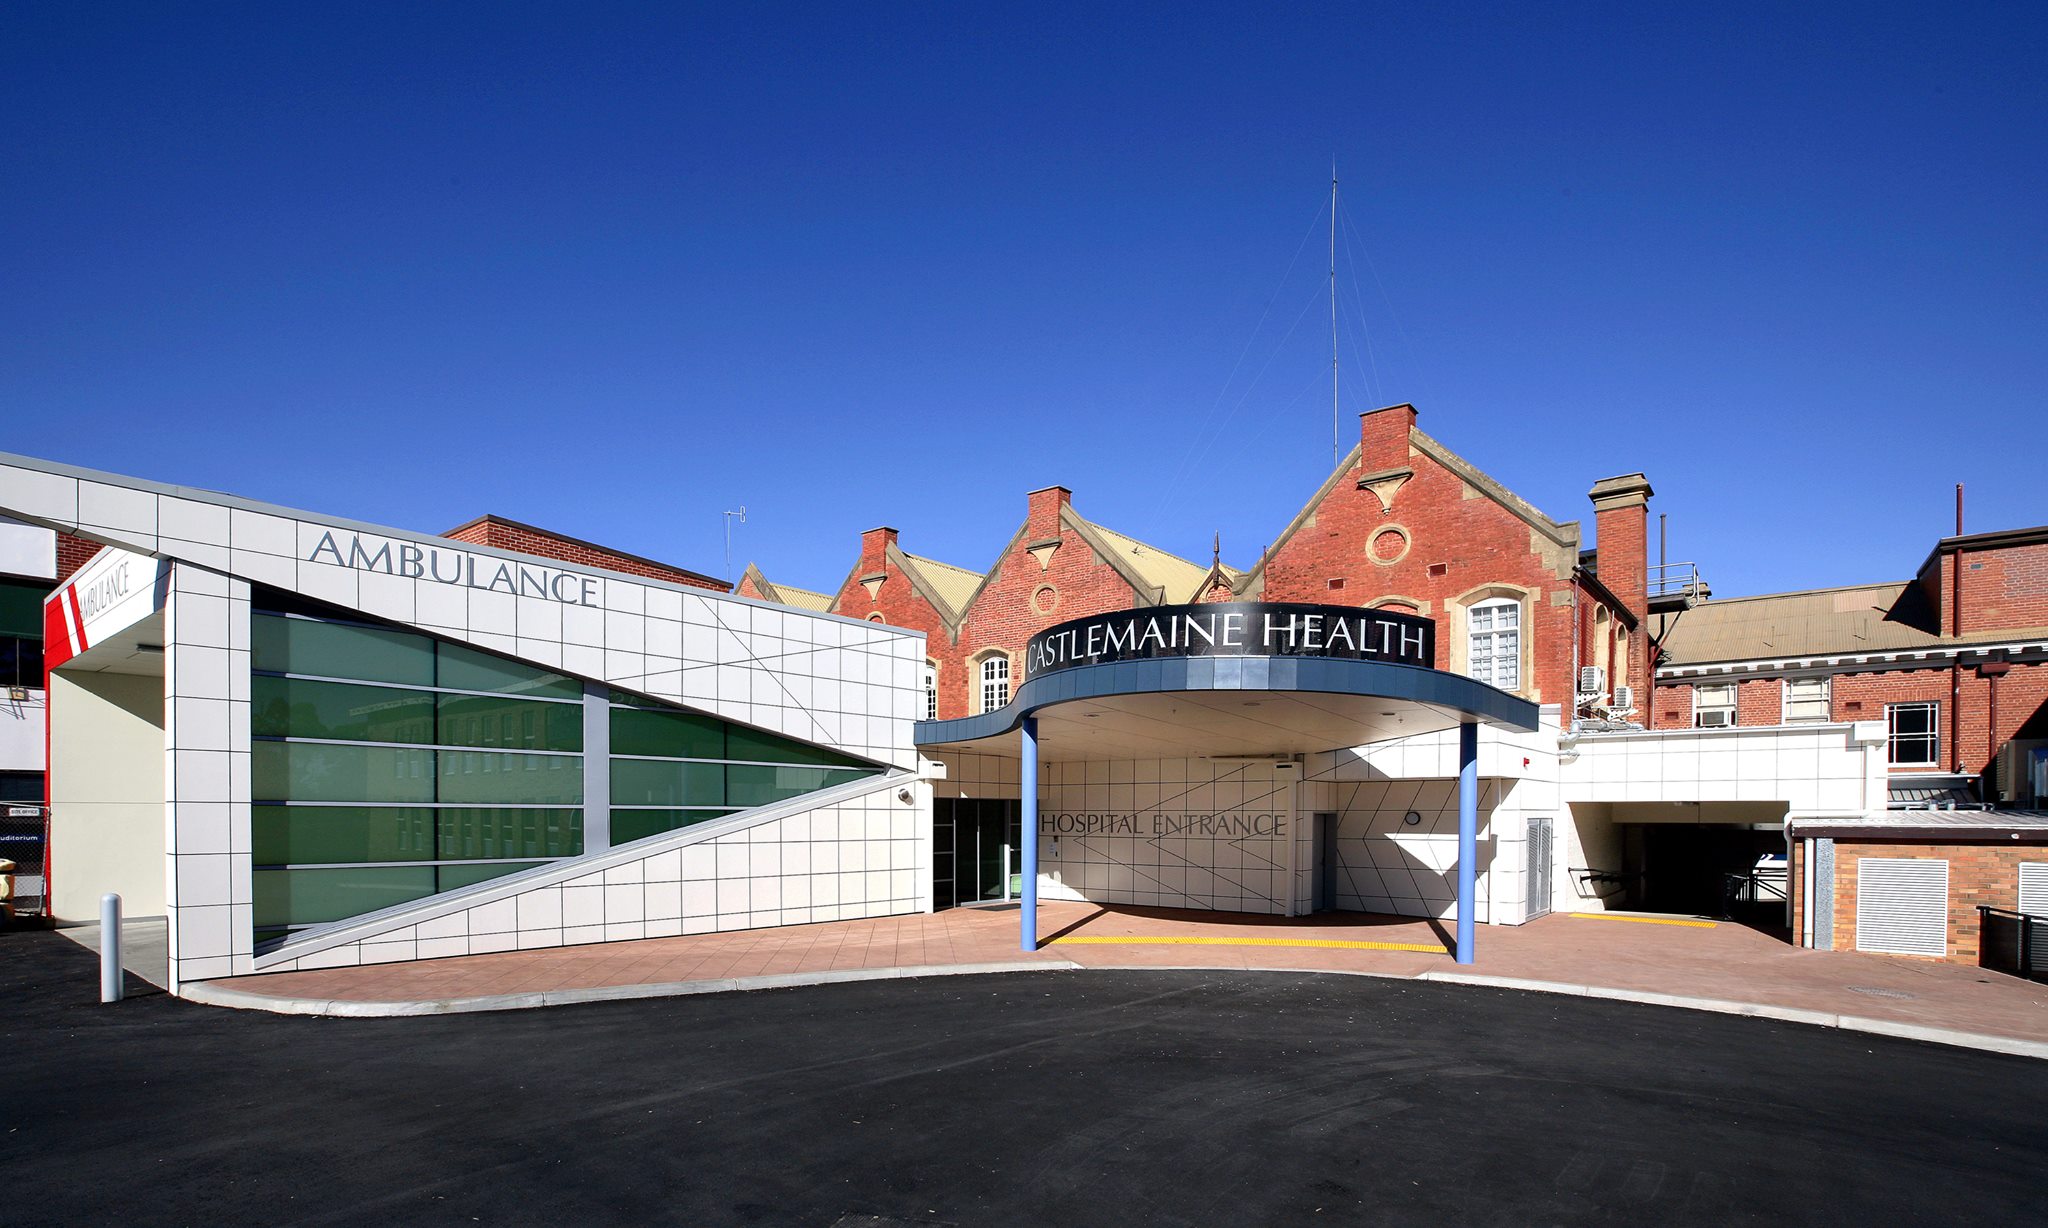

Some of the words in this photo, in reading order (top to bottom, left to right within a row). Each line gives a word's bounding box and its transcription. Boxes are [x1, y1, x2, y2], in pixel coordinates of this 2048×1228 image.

[80, 561, 129, 621] AMBULANCE
[309, 530, 598, 608] AMBULANCE
[1028, 613, 1243, 673] CASTLEMAINE
[1264, 613, 1424, 659] HEALTH
[1041, 813, 1144, 834] HOSPITAL
[1153, 814, 1287, 836] ENTRANCE
